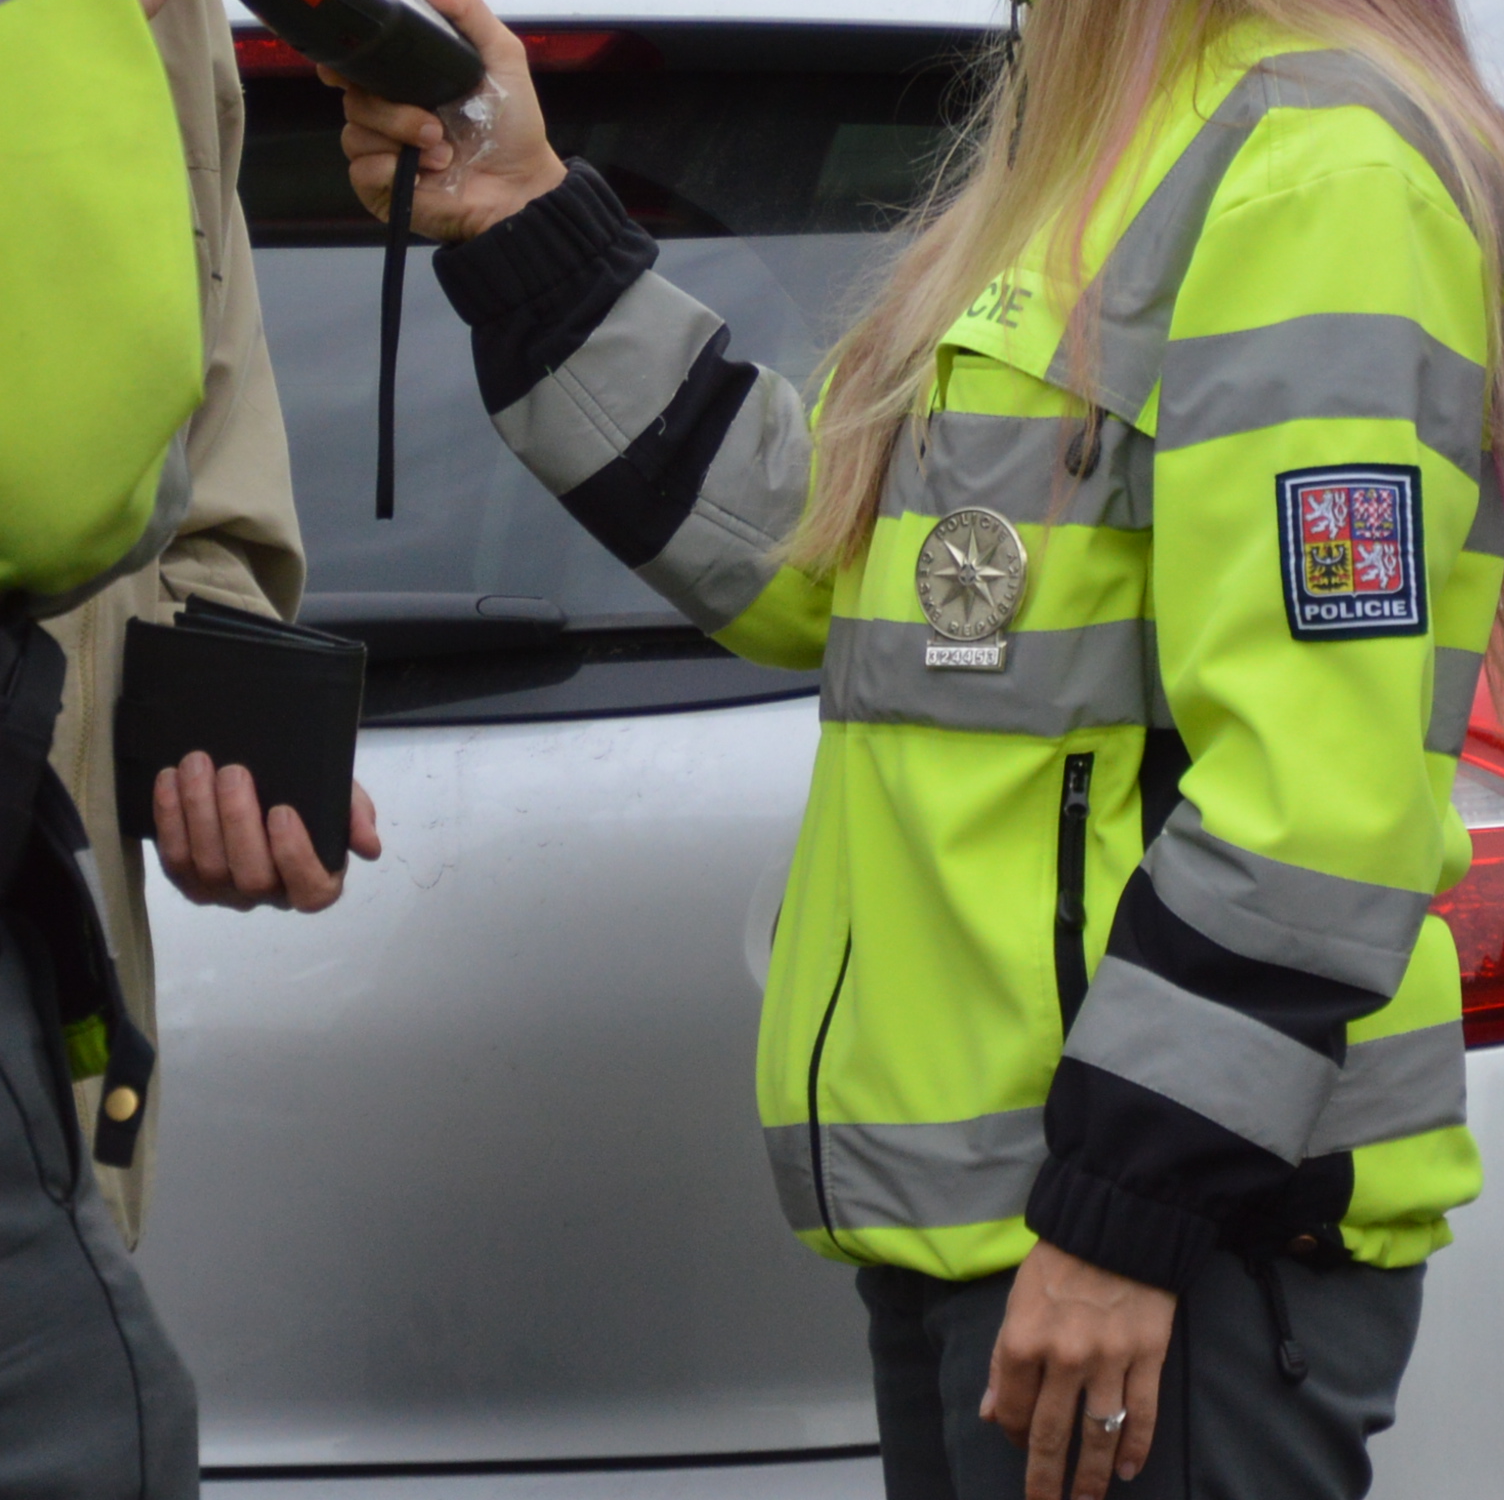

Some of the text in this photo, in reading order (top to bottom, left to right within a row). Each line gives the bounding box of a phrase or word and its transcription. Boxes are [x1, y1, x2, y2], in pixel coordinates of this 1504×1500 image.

[936, 513, 1009, 543] POLICIE
[1304, 600, 1407, 621] POLICIE
[928, 649, 997, 665] 324453
